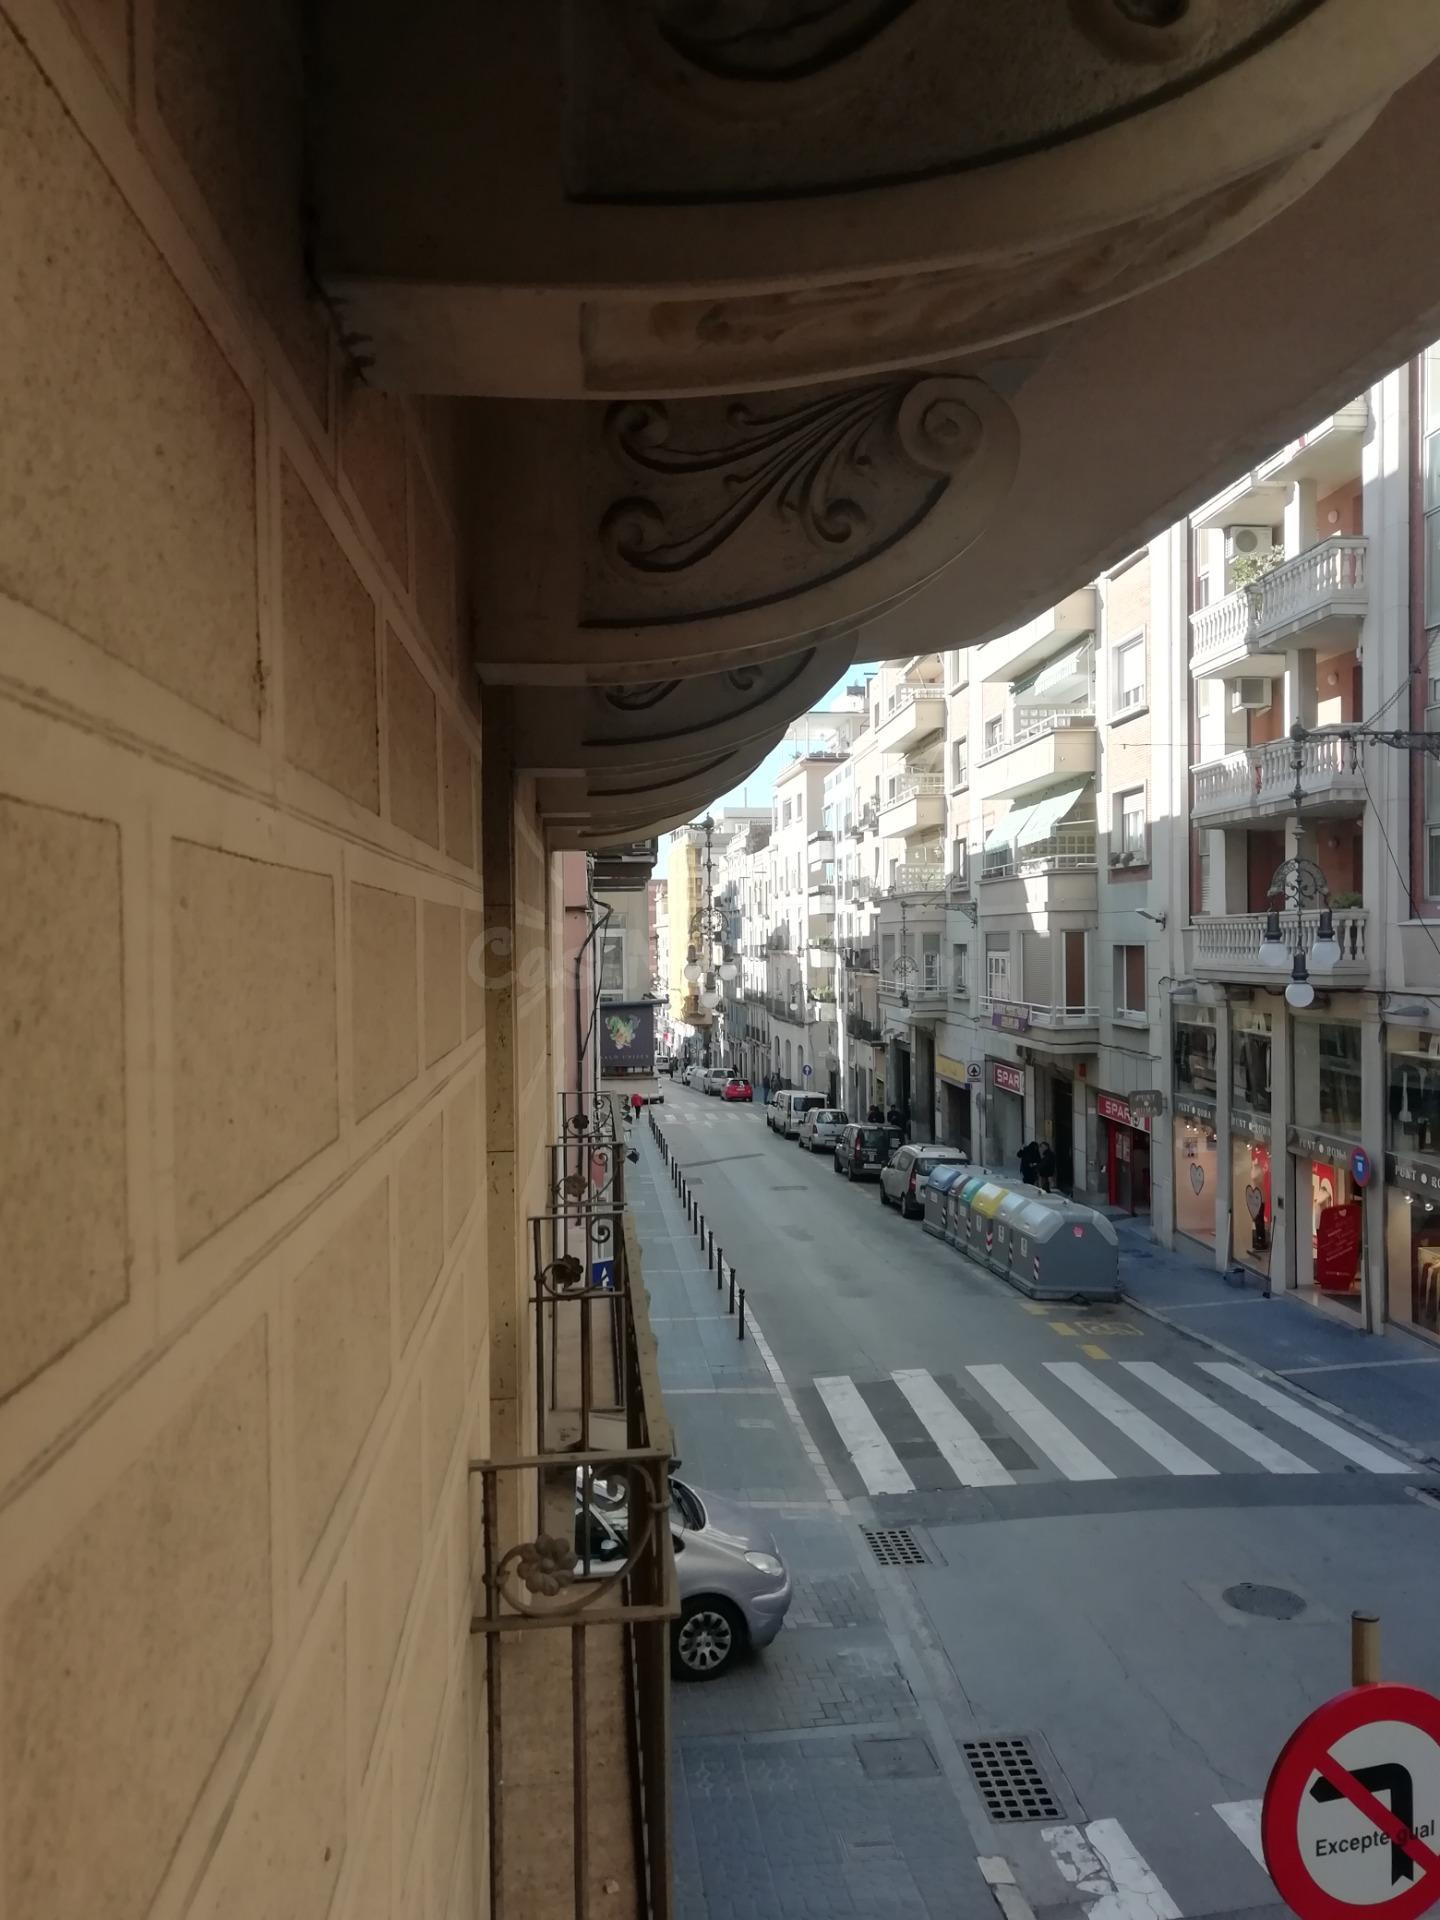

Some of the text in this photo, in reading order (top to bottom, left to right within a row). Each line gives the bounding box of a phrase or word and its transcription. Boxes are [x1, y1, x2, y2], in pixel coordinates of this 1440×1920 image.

[996, 1069, 1020, 1088] SPAR
[1105, 1101, 1131, 1121] SPAR
[1395, 1165, 1417, 1181] PUNT
[1315, 1819, 1435, 1857] Excepte gual
